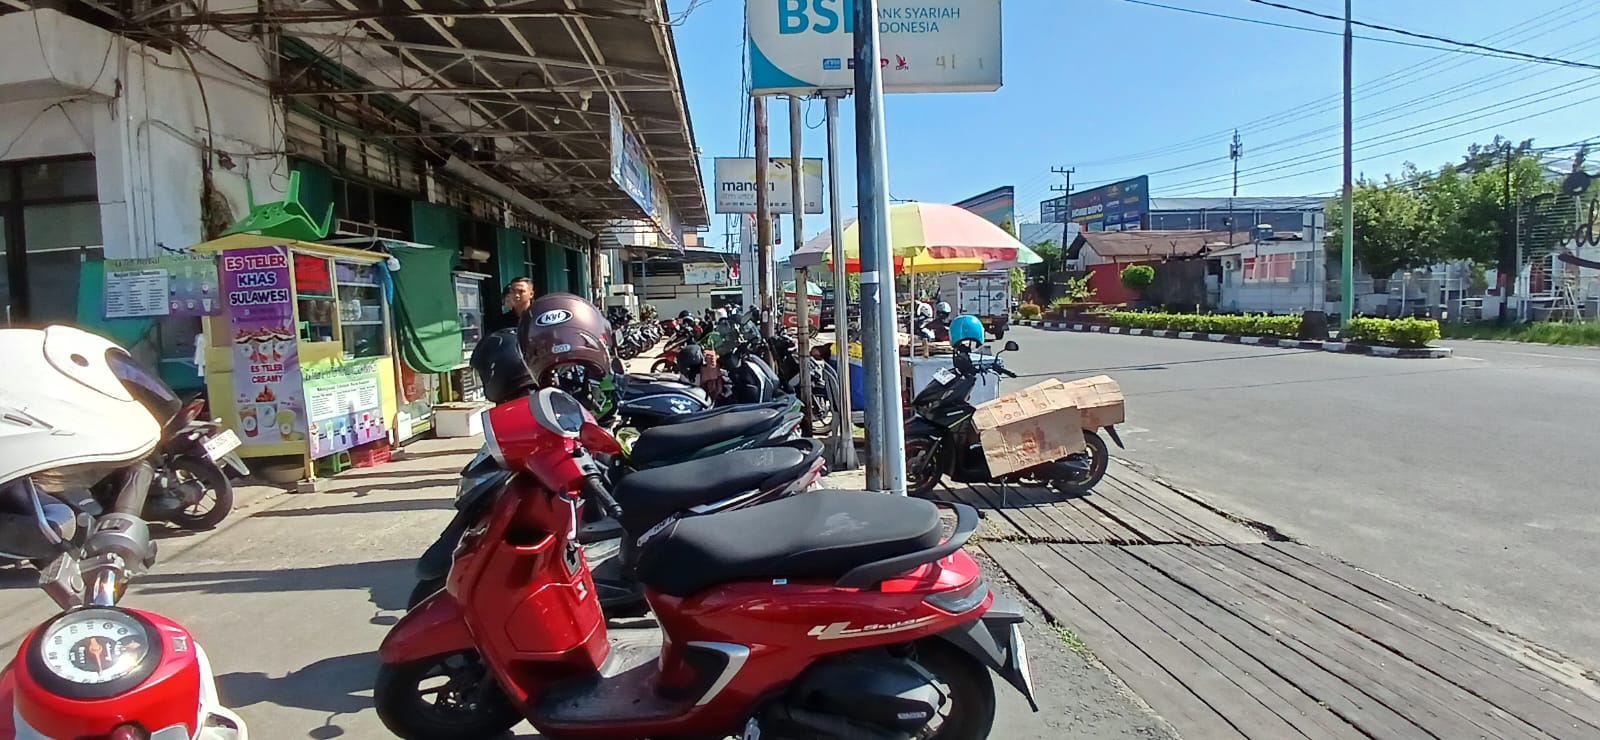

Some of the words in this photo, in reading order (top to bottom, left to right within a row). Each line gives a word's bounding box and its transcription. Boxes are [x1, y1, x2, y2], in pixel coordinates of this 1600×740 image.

[904, 8, 960, 19] SYARIAH
[879, 21, 939, 33] DONESIA
[226, 258, 247, 270] ES
[249, 255, 287, 268] TELER
[238, 272, 276, 287] KHAS
[230, 290, 288, 304] SULAWESI
[251, 375, 283, 383] CREAMY
